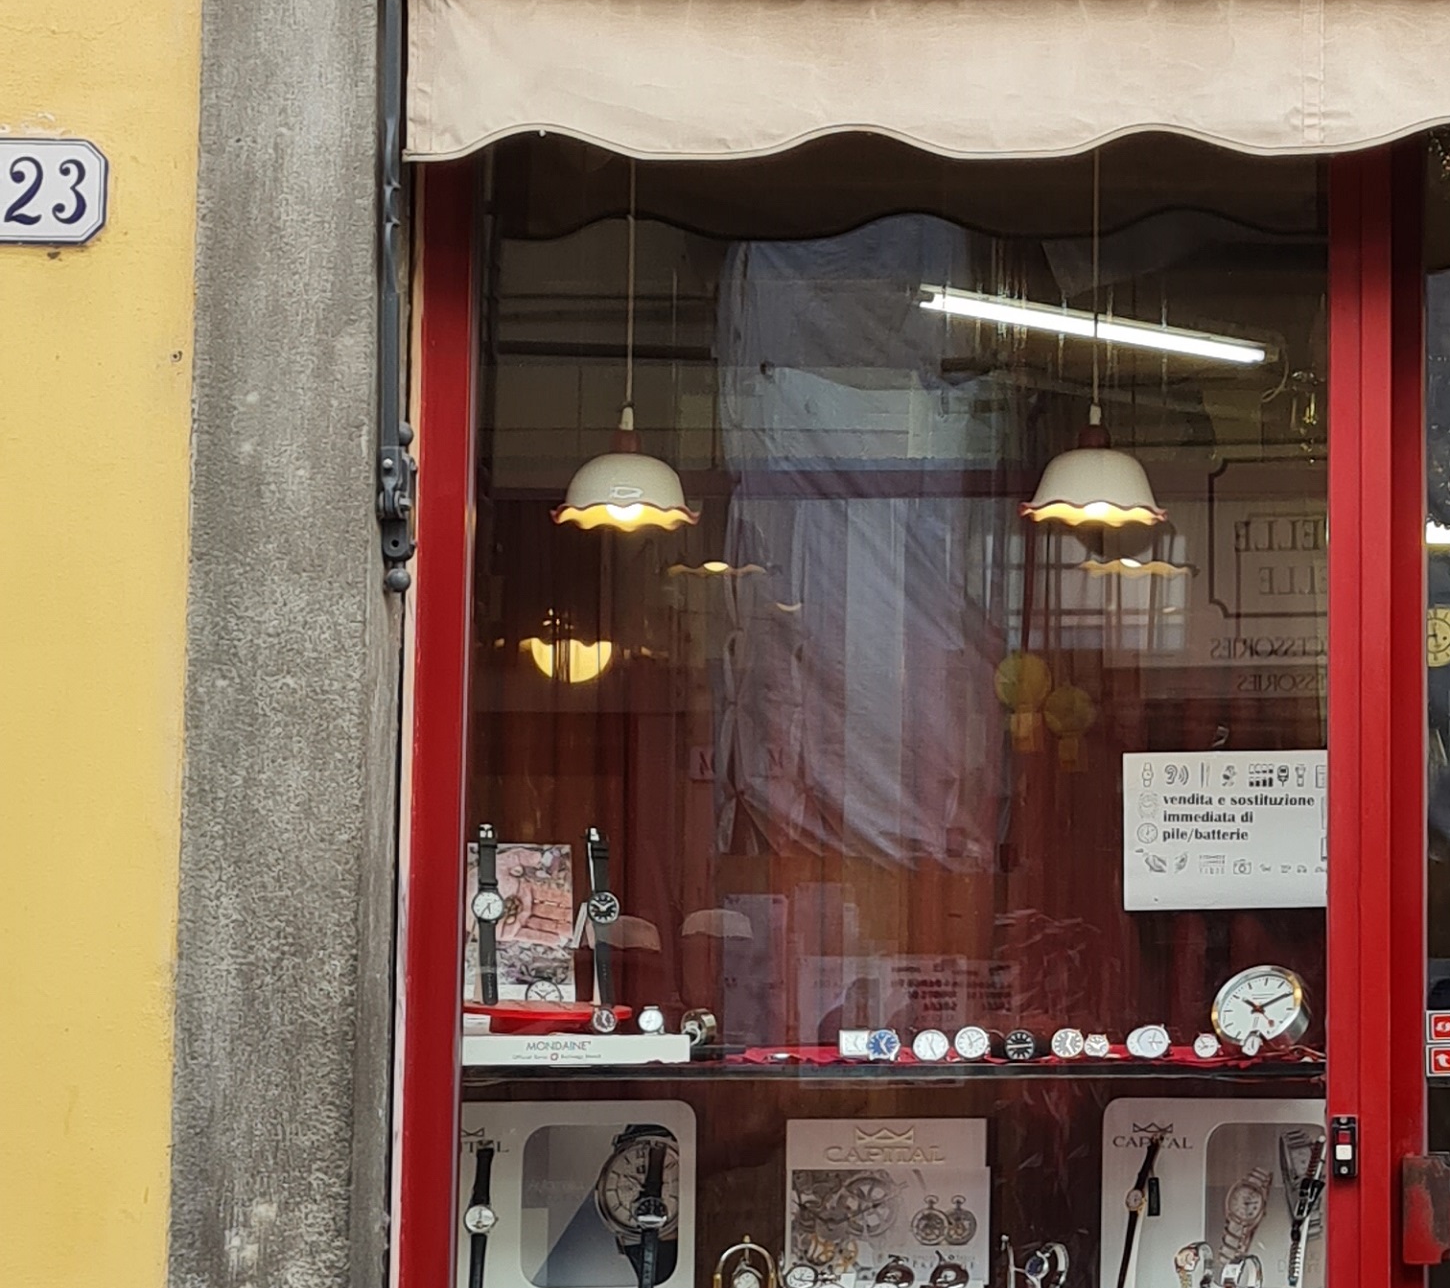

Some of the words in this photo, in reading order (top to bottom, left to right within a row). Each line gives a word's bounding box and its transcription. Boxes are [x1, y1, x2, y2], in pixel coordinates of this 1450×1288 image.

[4, 156, 87, 225] 23
[1162, 794, 1213, 806] vendita
[1218, 796, 1226, 806] e
[1230, 793, 1315, 807] sostituzione
[1163, 810, 1236, 823] immediata
[1240, 810, 1254, 823] di
[1162, 828, 1249, 843] pile/batterie
[526, 1041, 588, 1051] MONDAINE
[1112, 1135, 1193, 1149] CAPAL
[823, 1145, 946, 1164] CAPITAL
